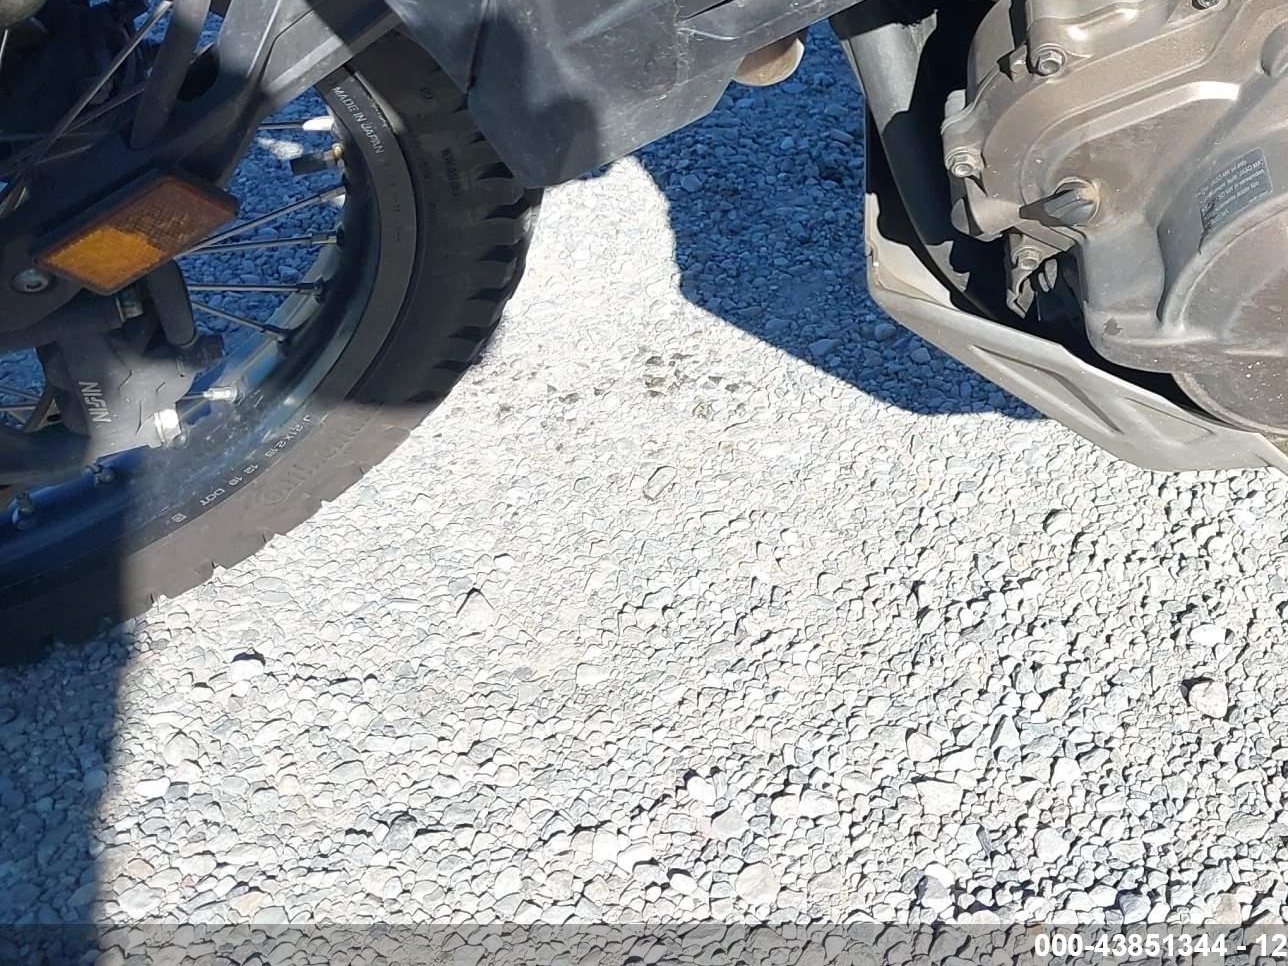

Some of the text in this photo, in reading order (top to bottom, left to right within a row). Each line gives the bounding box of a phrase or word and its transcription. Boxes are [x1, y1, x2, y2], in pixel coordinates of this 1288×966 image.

[332, 86, 385, 154] MADE IN JAPAN
[200, 487, 226, 506] DOT
